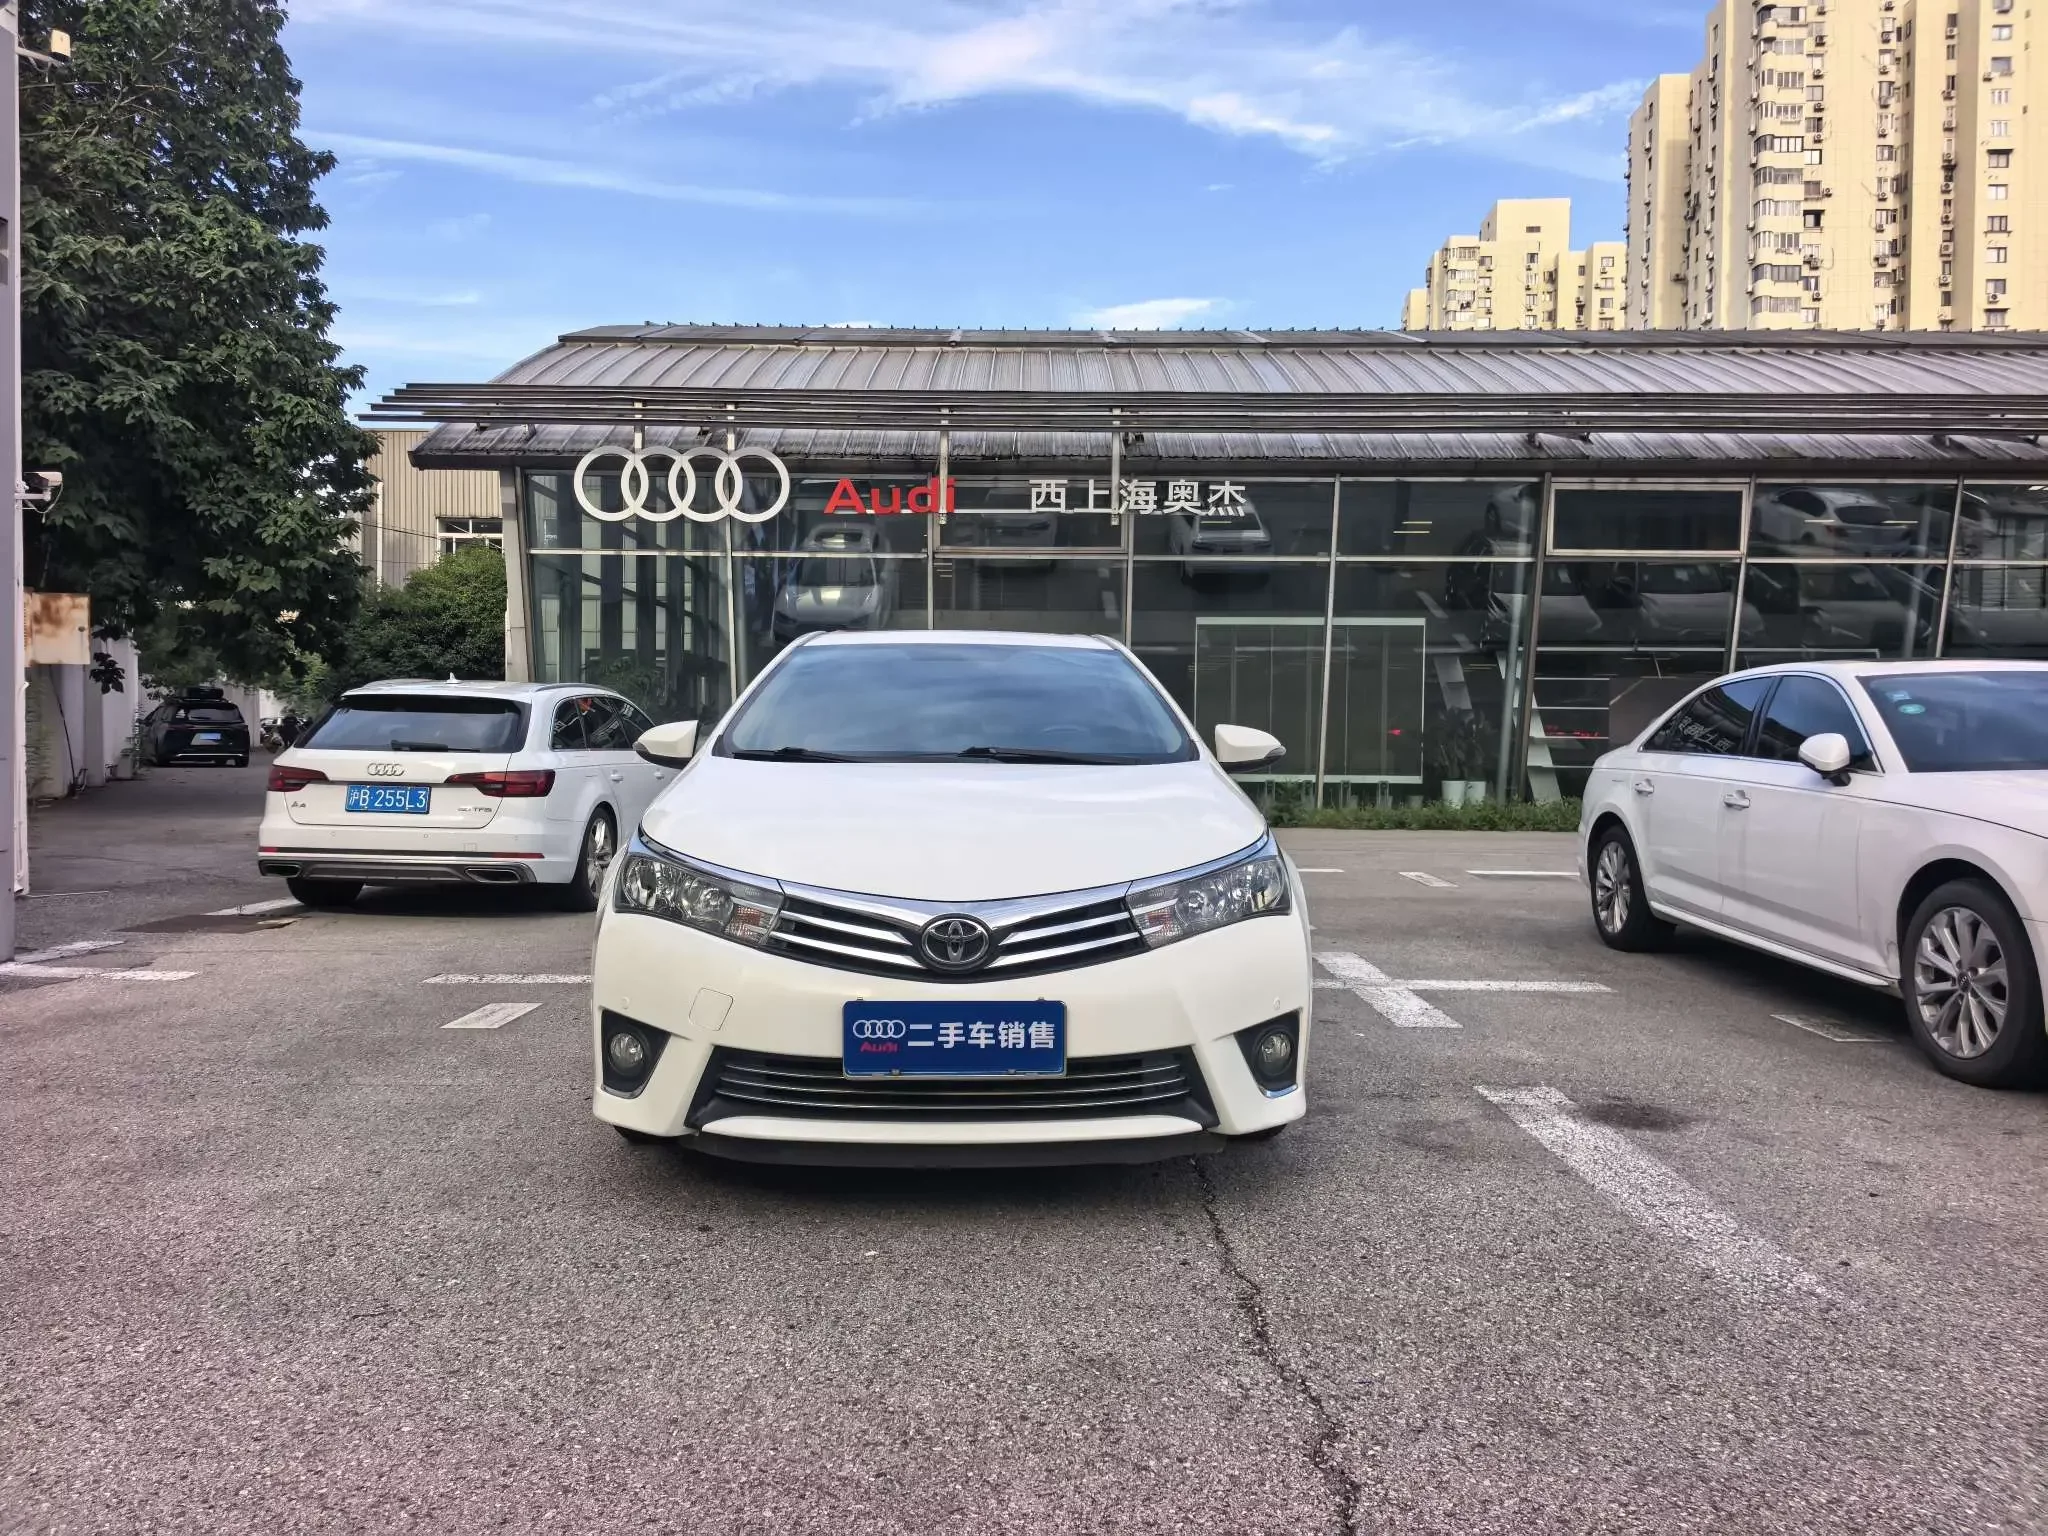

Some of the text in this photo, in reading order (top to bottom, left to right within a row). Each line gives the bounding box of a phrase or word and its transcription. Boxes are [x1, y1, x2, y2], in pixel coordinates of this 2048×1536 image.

[824, 476, 956, 514] Audi
[1029, 479, 1247, 516] 西上海奥杰
[860, 1041, 898, 1053] Audi
[908, 1021, 1055, 1049] 二手车销售
